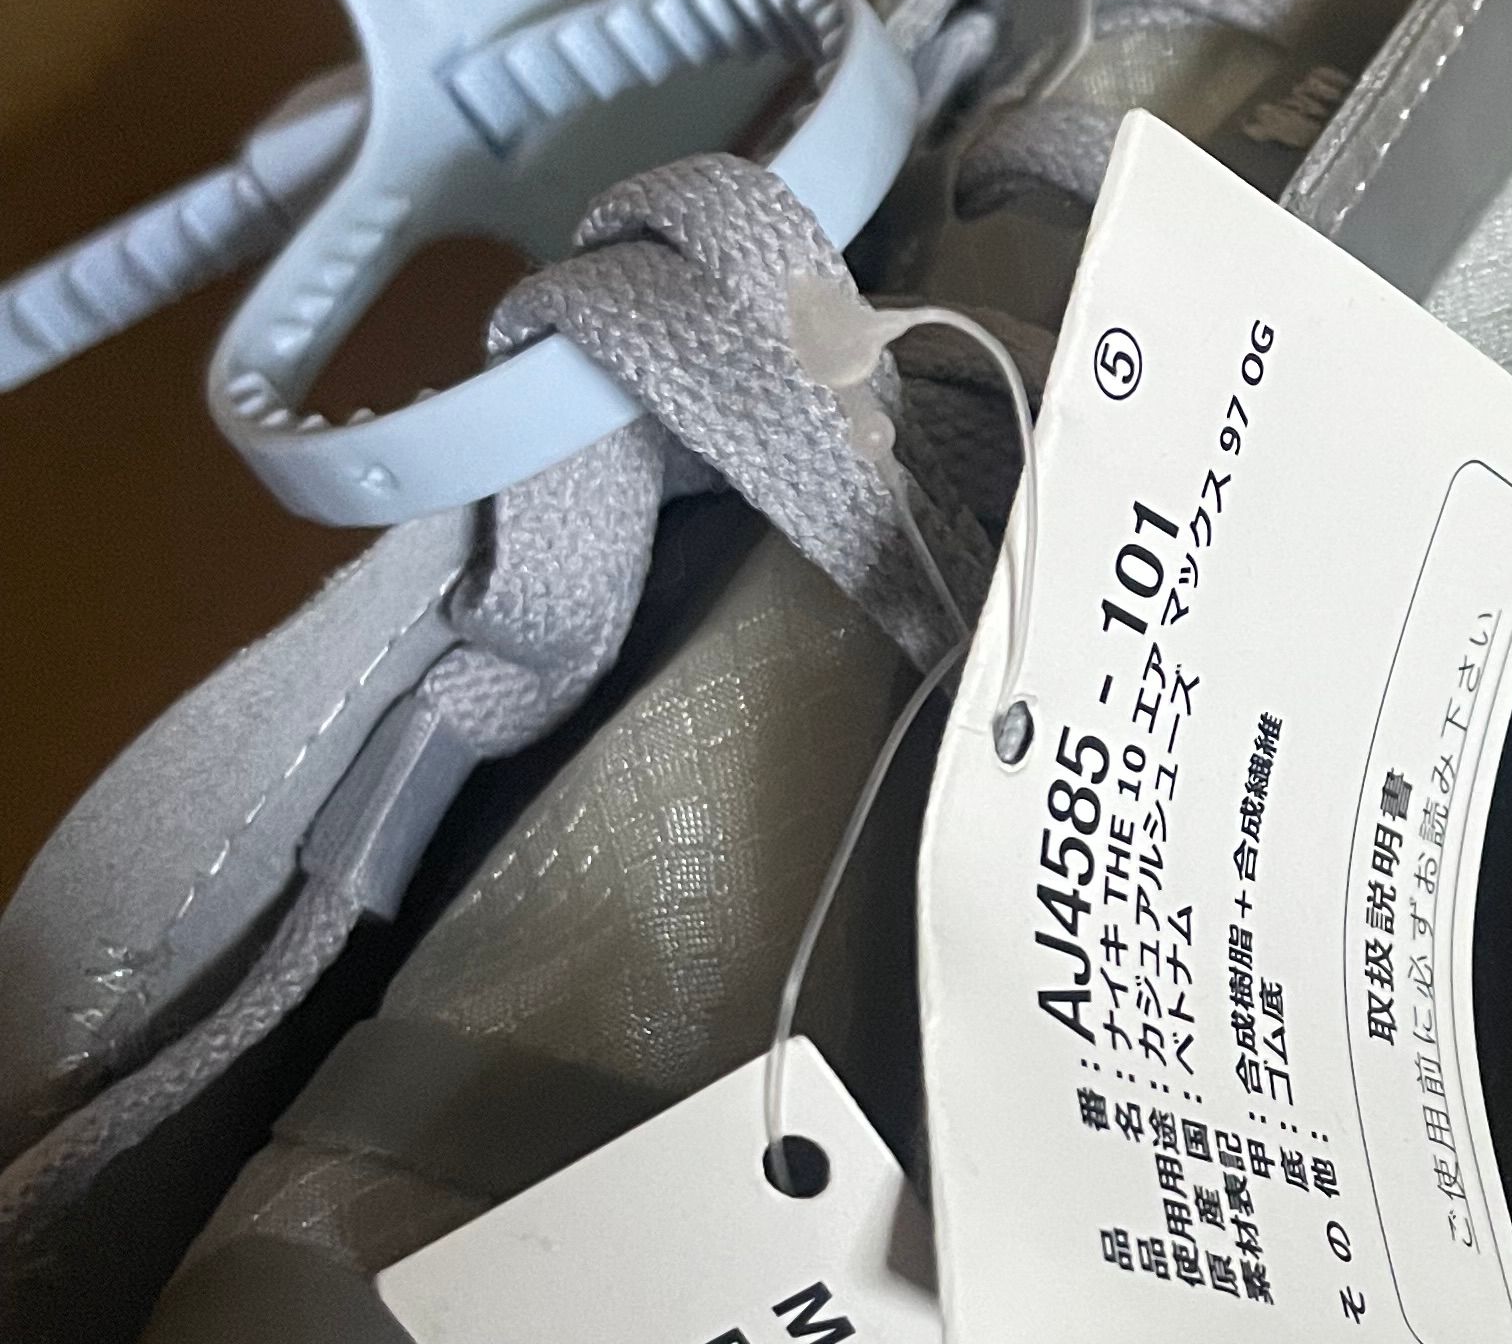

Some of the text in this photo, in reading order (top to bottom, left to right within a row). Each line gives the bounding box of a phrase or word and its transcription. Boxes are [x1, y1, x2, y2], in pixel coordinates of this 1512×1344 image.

[1241, 319, 1276, 387] OG
[1220, 394, 1248, 456] 97
[1162, 469, 1231, 626] マックス
[1132, 642, 1167, 734] エア
[1036, 726, 1111, 1043] AJ4585
[1102, 500, 1180, 643] 101
[1118, 740, 1147, 802] 10
[1105, 816, 1137, 903] THE
[1365, 767, 1412, 1045] 取扱説明書
[1408, 612, 1492, 1247] ご使用前に必ずお読み下さい
[1101, 922, 1133, 1051] ナイキ
